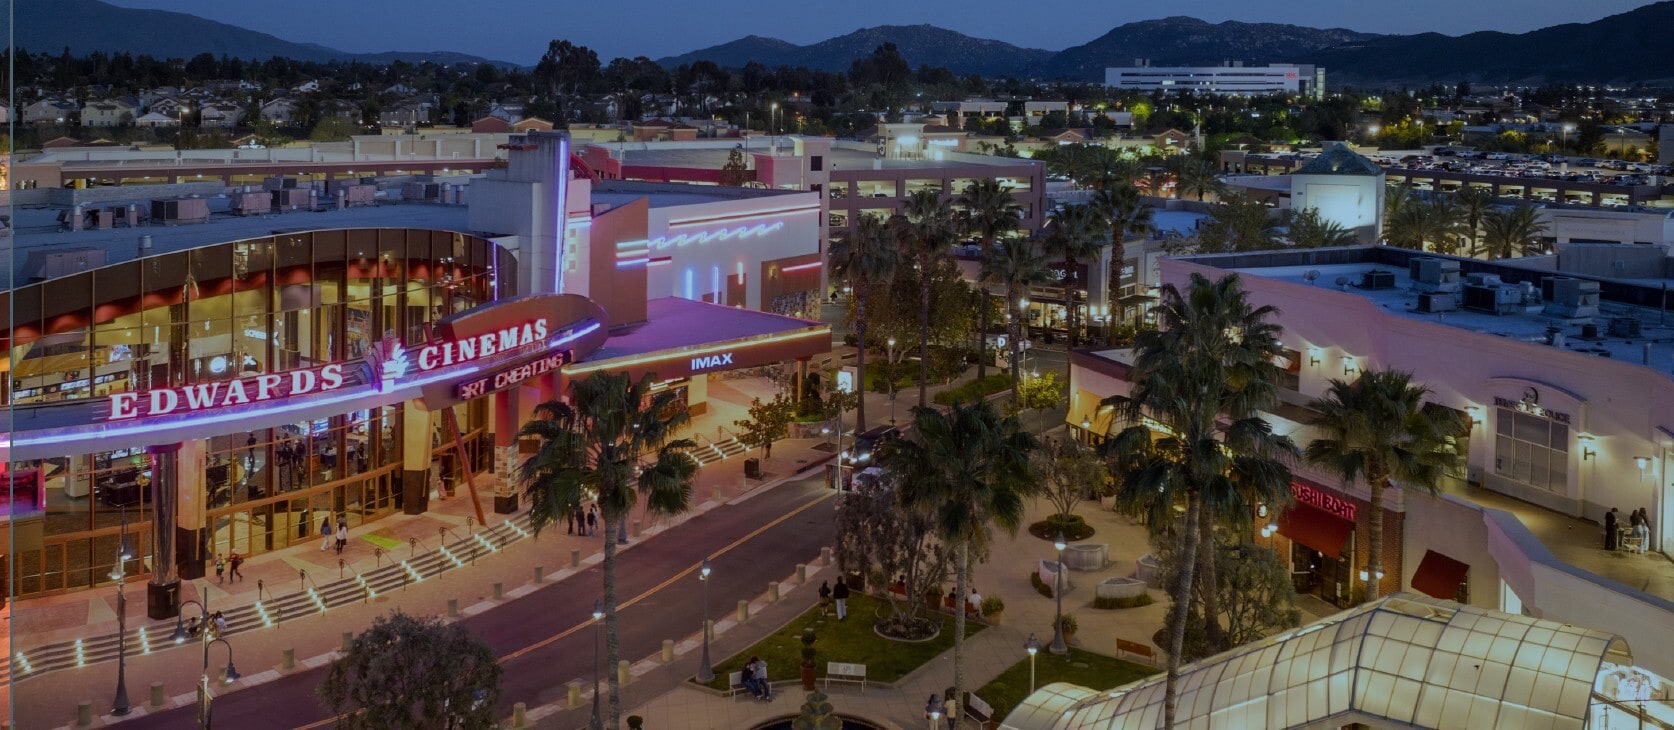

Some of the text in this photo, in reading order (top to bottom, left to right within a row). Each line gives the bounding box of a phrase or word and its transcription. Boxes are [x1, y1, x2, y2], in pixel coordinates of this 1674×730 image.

[418, 318, 547, 370] CINEMAS
[691, 353, 733, 370] IMAX
[108, 363, 344, 421] EDWARDS
[1290, 481, 1357, 520] SUSHI BOAT
